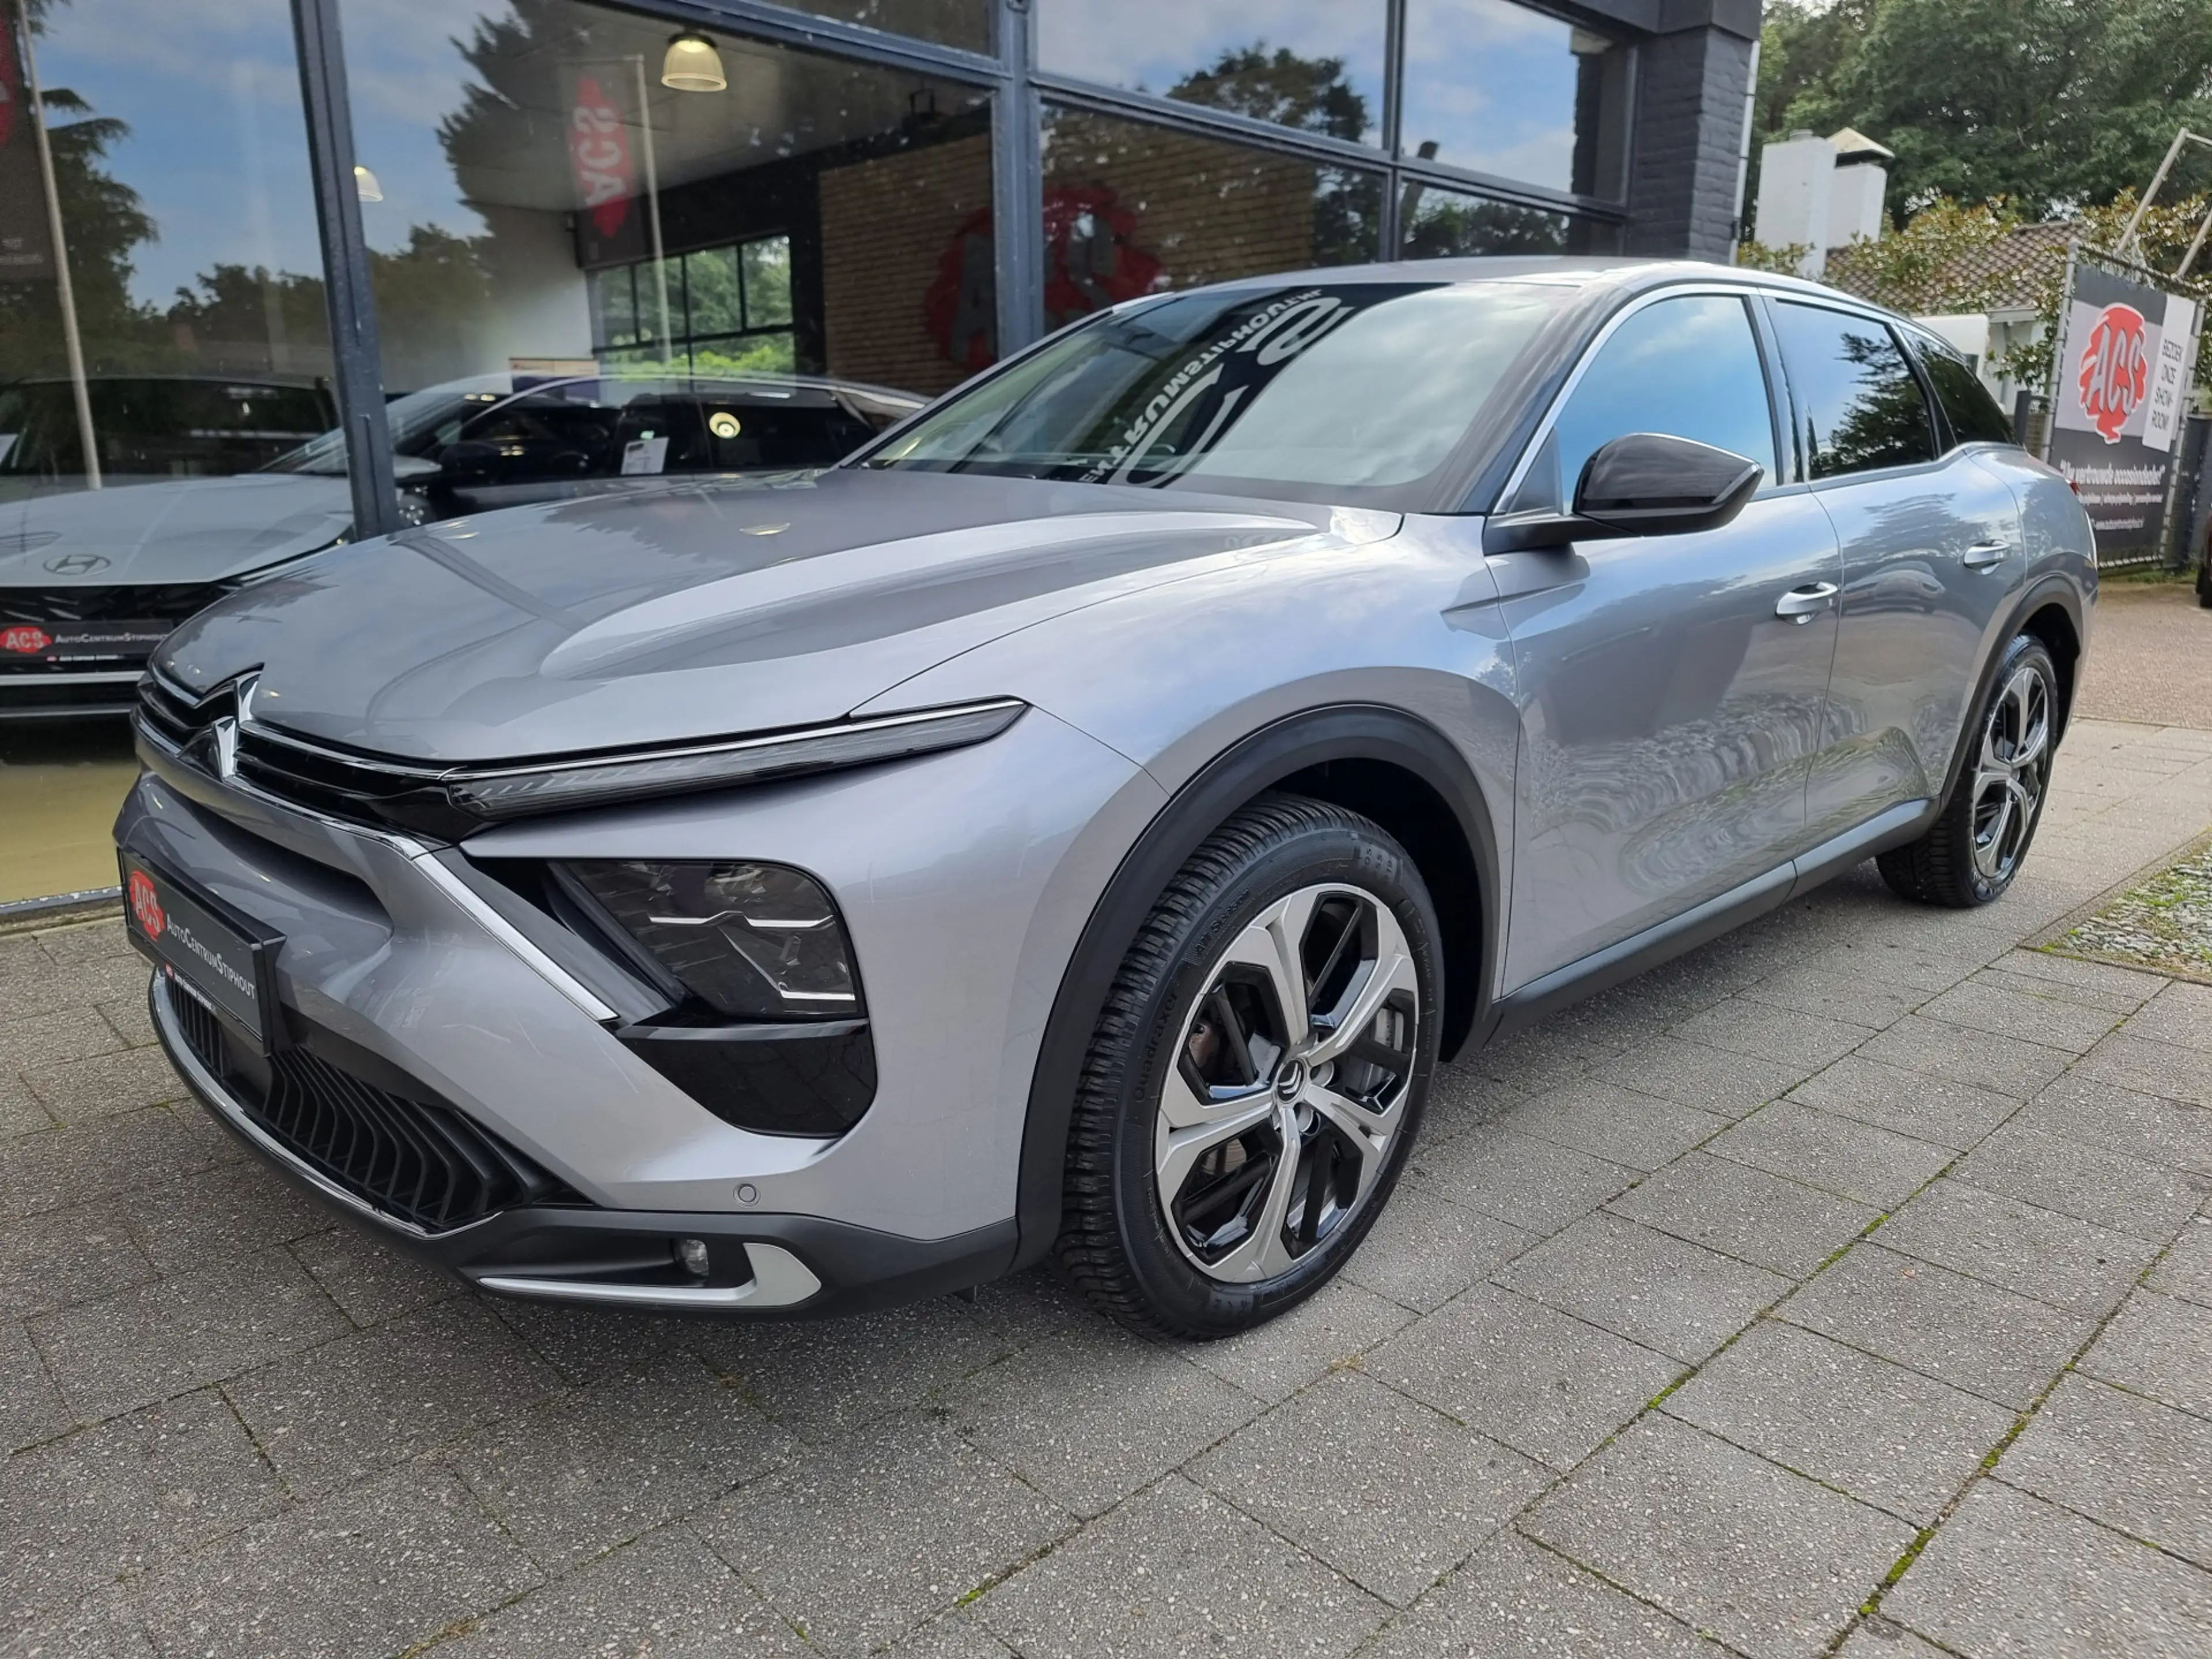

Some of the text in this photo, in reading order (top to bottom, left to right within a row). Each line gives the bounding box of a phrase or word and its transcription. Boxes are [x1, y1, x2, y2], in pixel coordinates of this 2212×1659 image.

[2085, 322, 2147, 417] ACS
[6, 631, 44, 649] ACS
[135, 879, 161, 933] ACS
